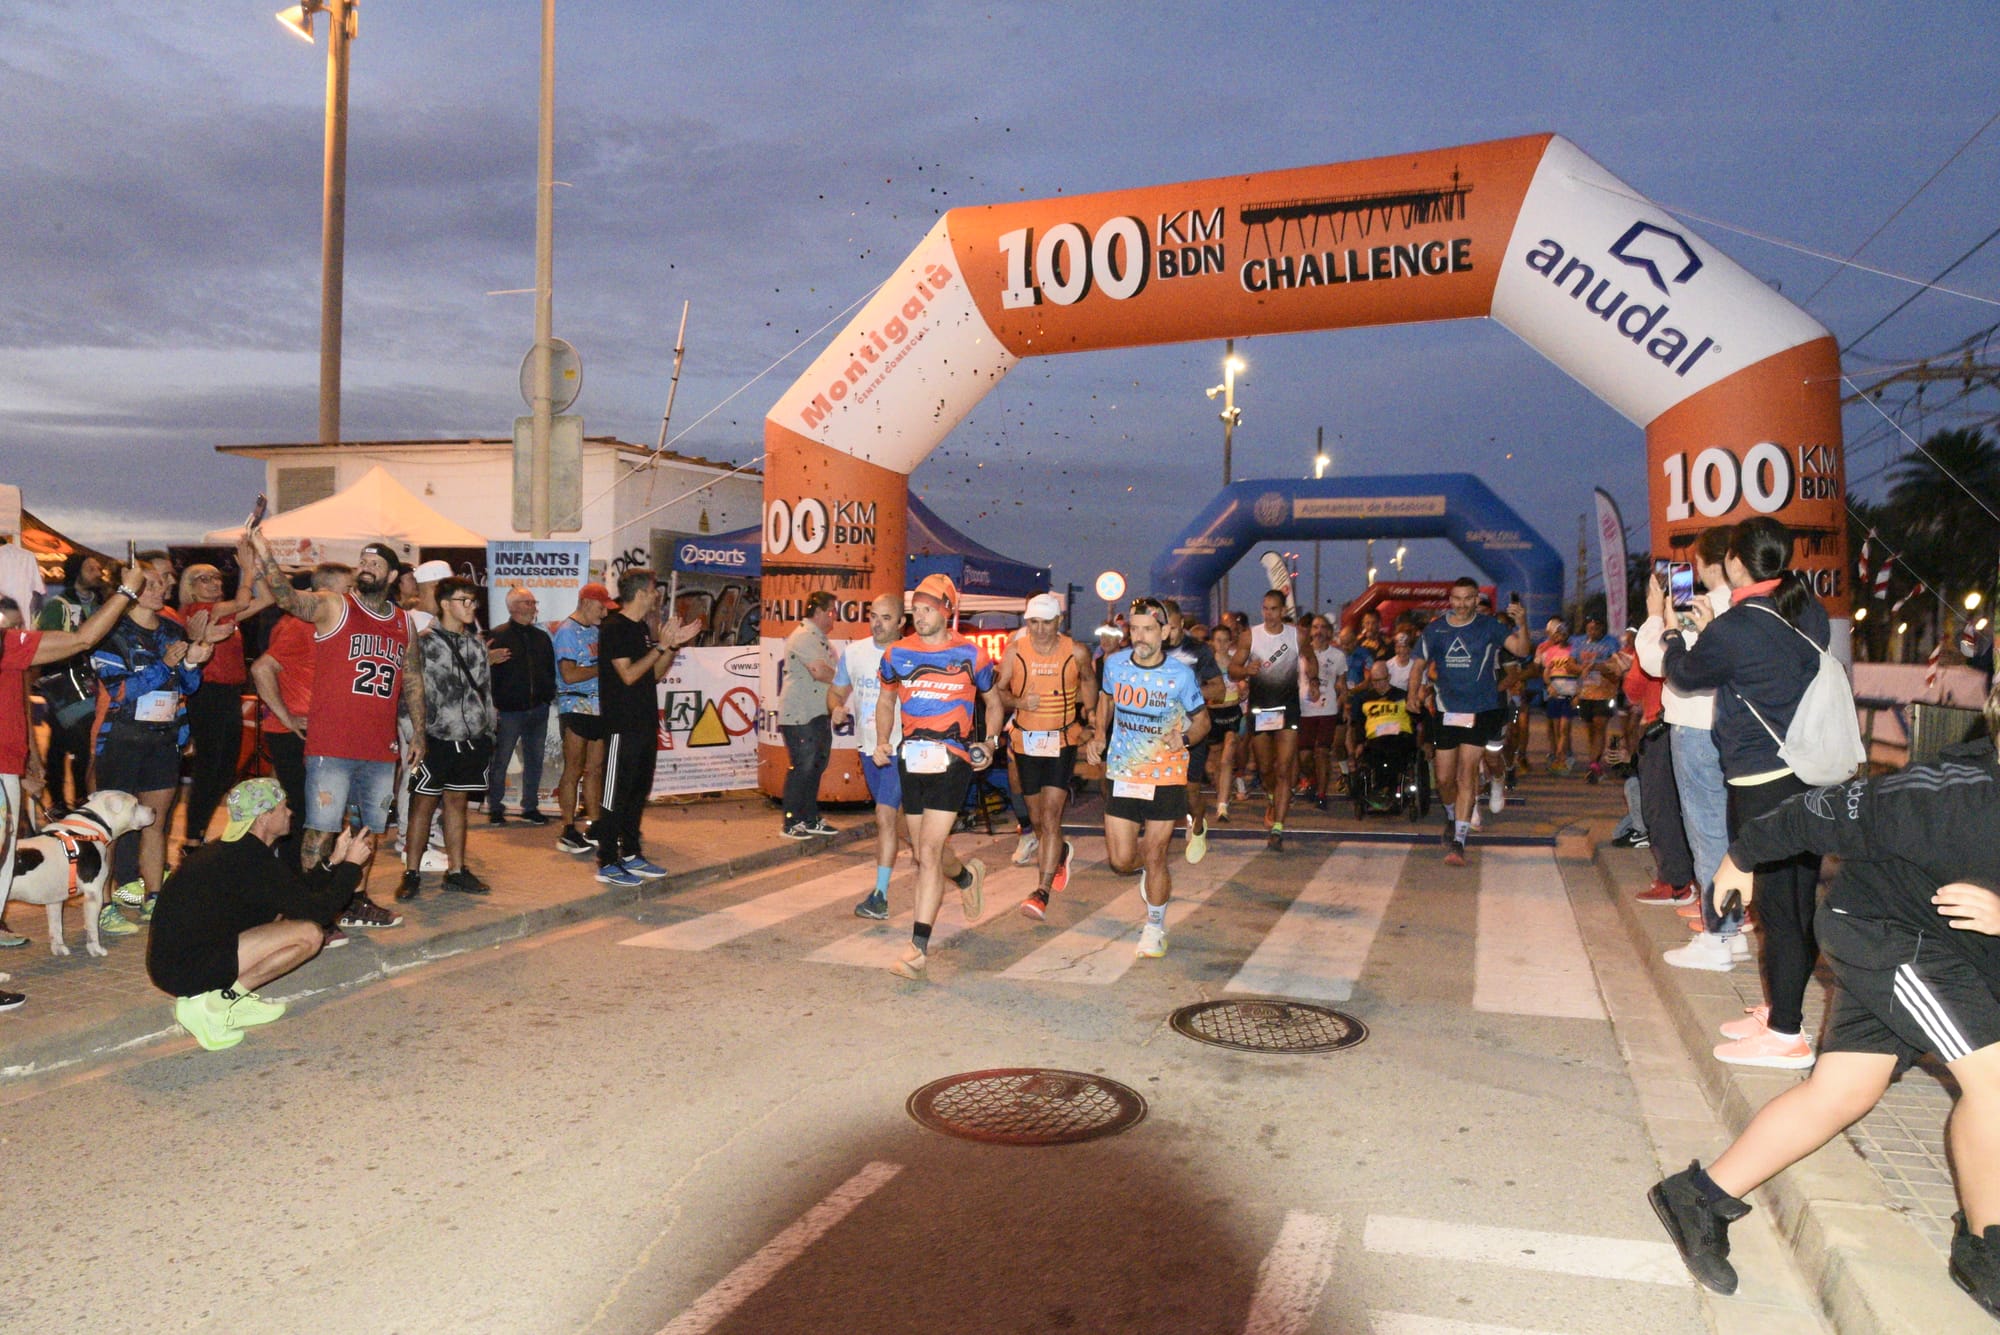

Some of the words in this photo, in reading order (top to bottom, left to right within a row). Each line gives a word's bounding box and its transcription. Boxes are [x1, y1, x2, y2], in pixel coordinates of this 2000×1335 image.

[999, 215, 1151, 310] 100
[1157, 207, 1225, 245] KM
[1157, 243, 1225, 280] BDN
[1240, 238, 1473, 293] CHALLENGE
[1525, 238, 1715, 378] anudal
[1663, 442, 1795, 522] 100
[1798, 443, 1837, 475] KM
[1799, 476, 1838, 501] BDN
[833, 500, 877, 525] KM
[833, 525, 877, 545] BDN
[494, 552, 570, 566] INFANTS
[574, 552, 580, 566] I
[494, 566, 579, 576] ADOLESCENTS
[494, 577, 524, 588] AMB
[348, 632, 405, 670] BULLS
[352, 660, 397, 699] 23
[1113, 682, 1149, 709] 100
[1150, 690, 1168, 700] KM
[1149, 699, 1167, 708] BDN
